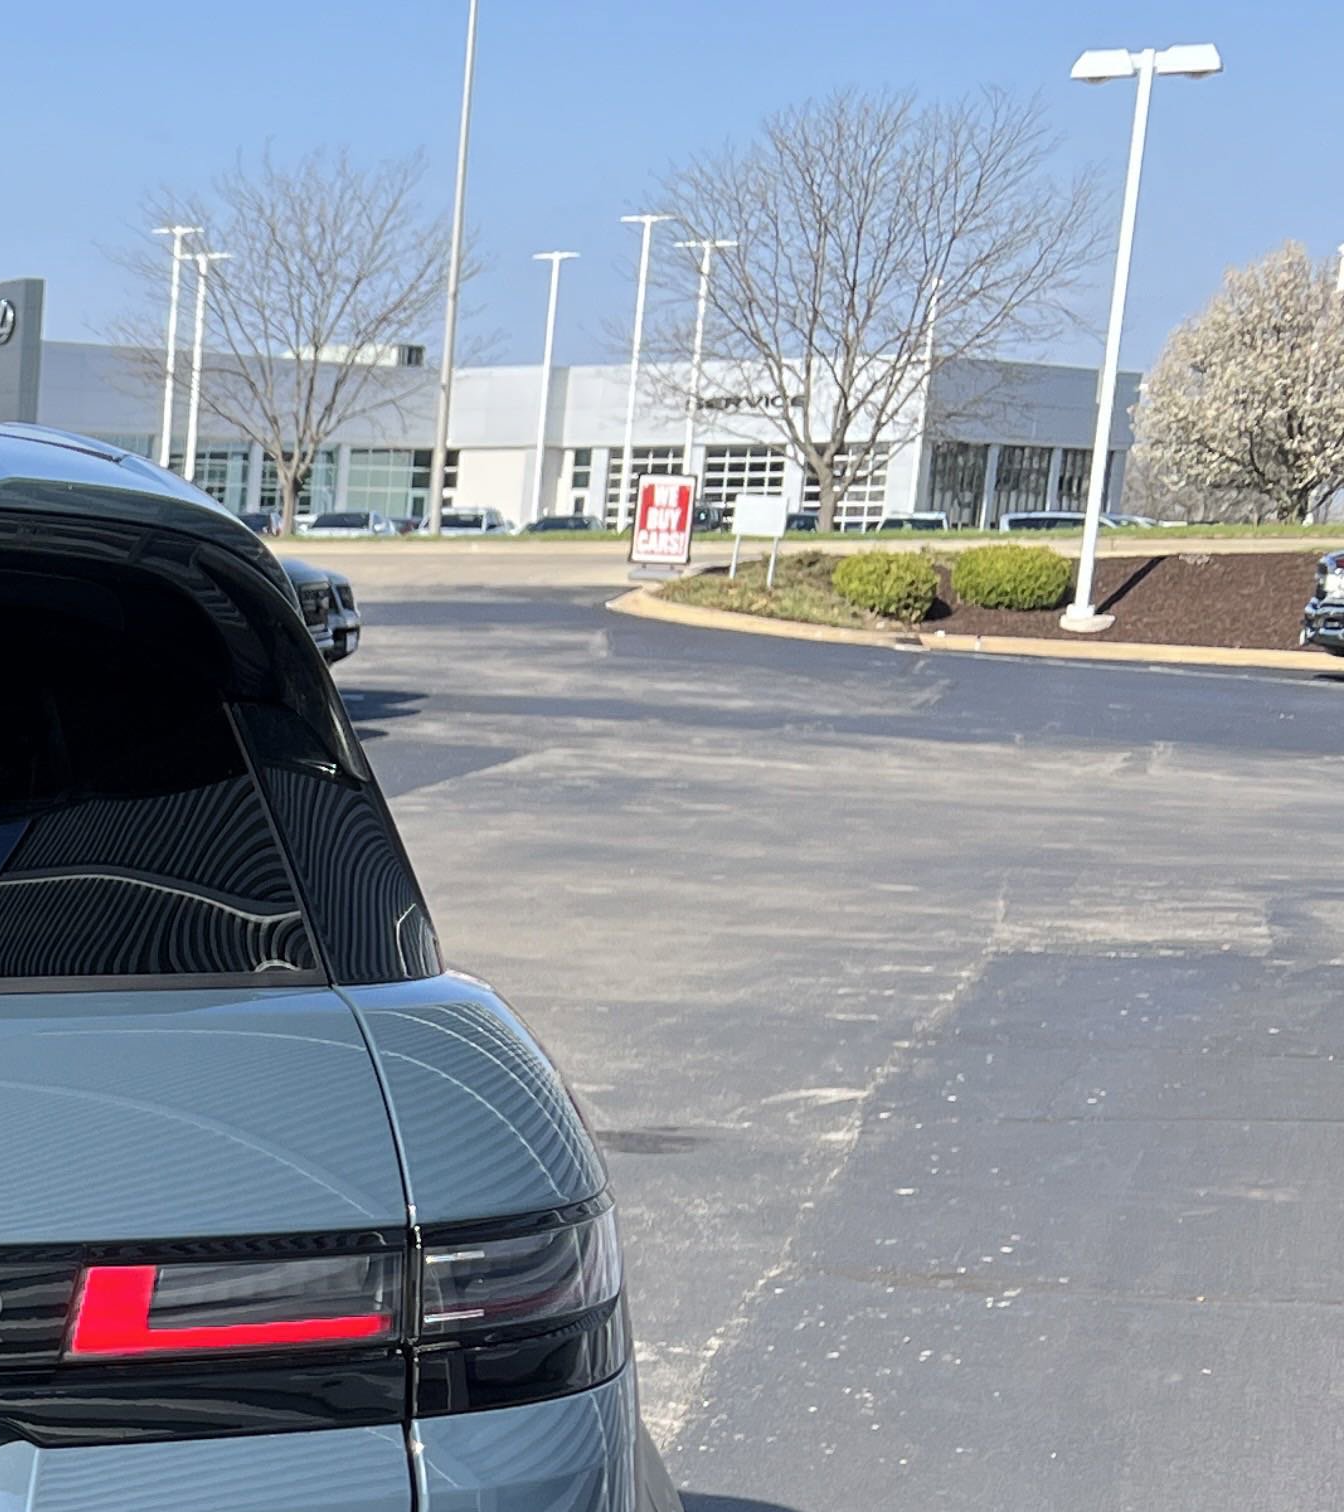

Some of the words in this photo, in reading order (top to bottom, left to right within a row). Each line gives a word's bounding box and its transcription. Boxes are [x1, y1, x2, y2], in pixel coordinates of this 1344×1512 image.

[654, 485, 681, 507] WE
[646, 506, 683, 530] BUY
[637, 529, 687, 555] CARS!
